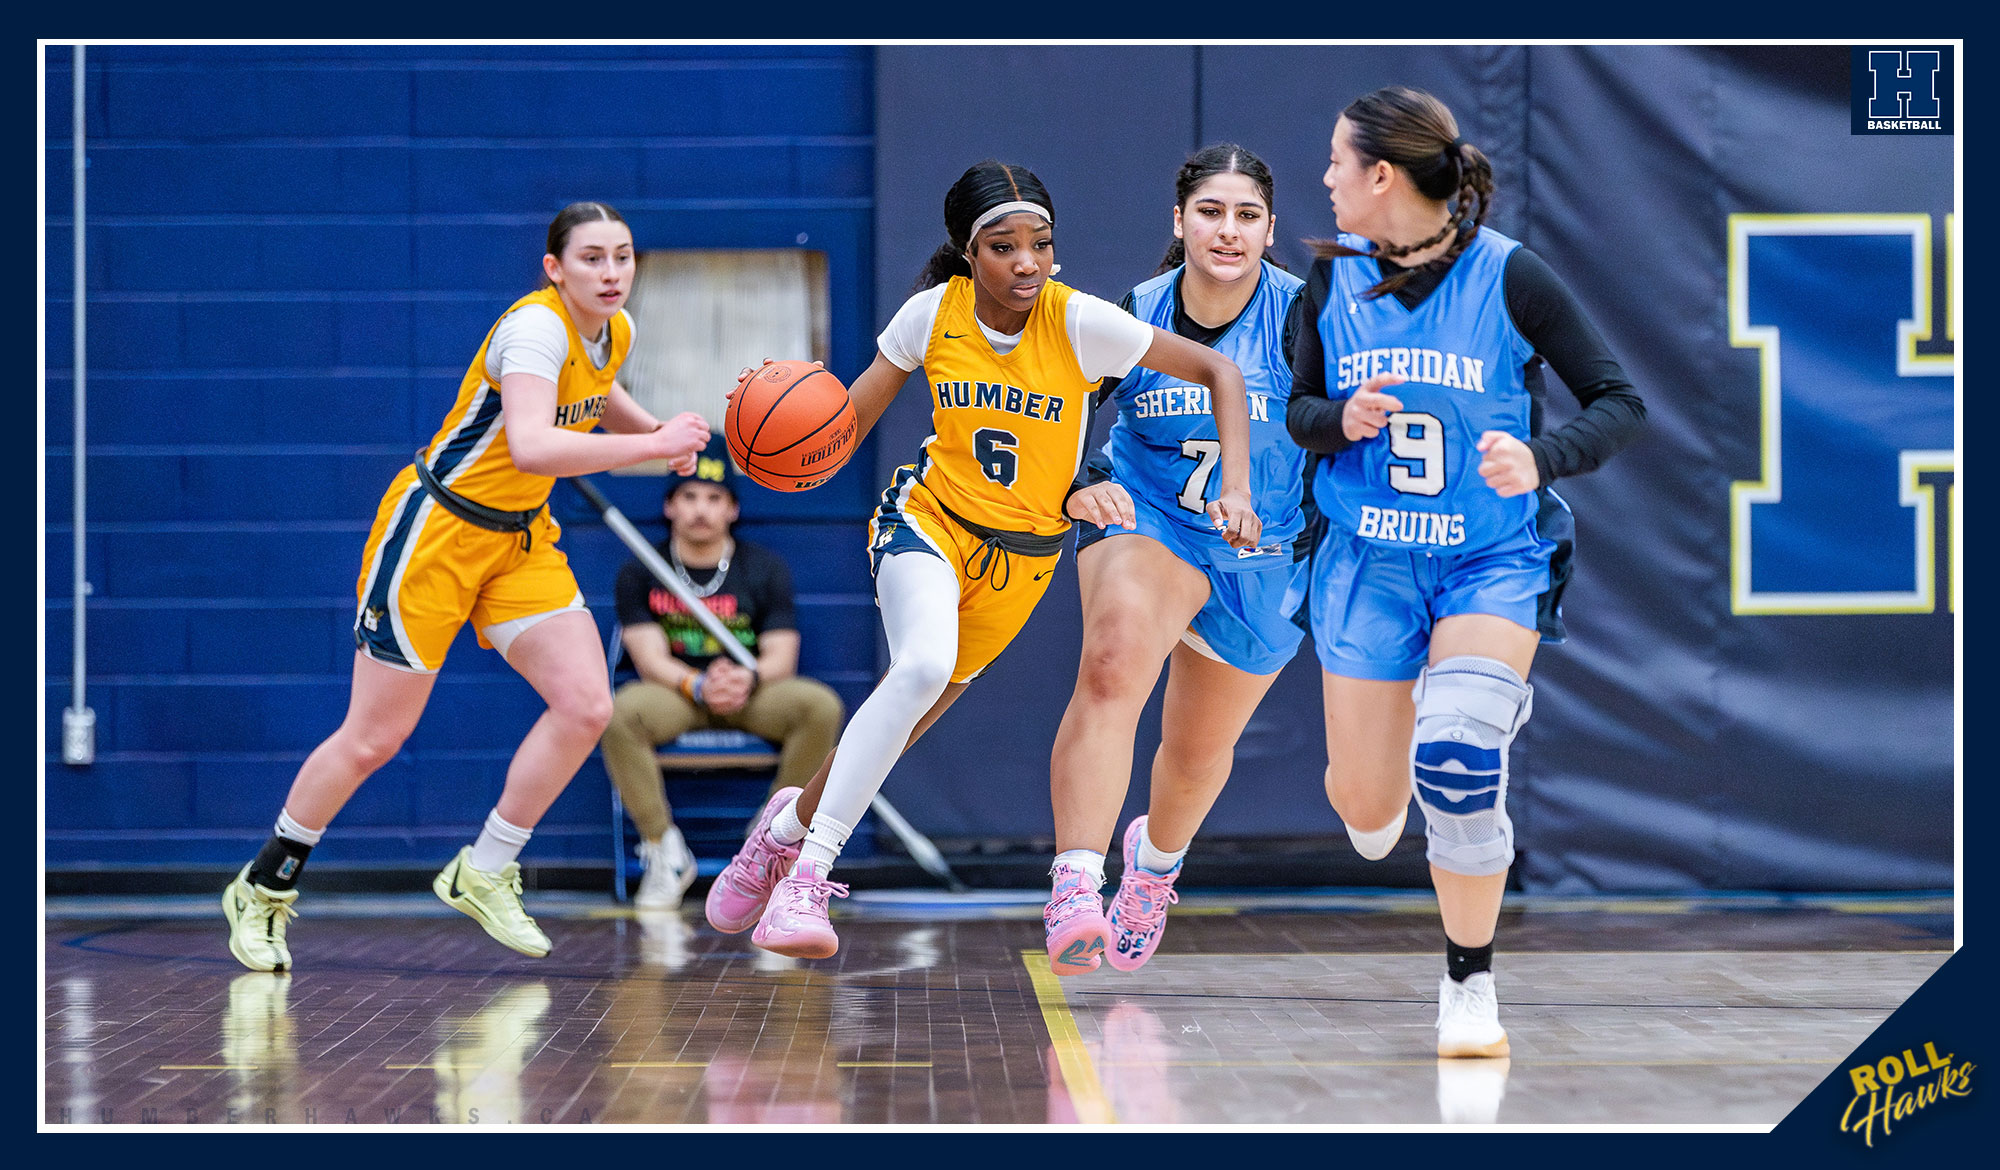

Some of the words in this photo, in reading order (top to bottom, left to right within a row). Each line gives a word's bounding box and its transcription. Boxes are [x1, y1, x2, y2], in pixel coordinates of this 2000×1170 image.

[1337, 347, 1485, 393] SHERIDAN
[936, 381, 1065, 423] HUMBER
[1133, 386, 1270, 423] SHERIN
[972, 426, 1020, 490] 6
[1176, 438, 1222, 516] 7
[1388, 411, 1447, 498] 9
[1356, 504, 1466, 546] BRUINS
